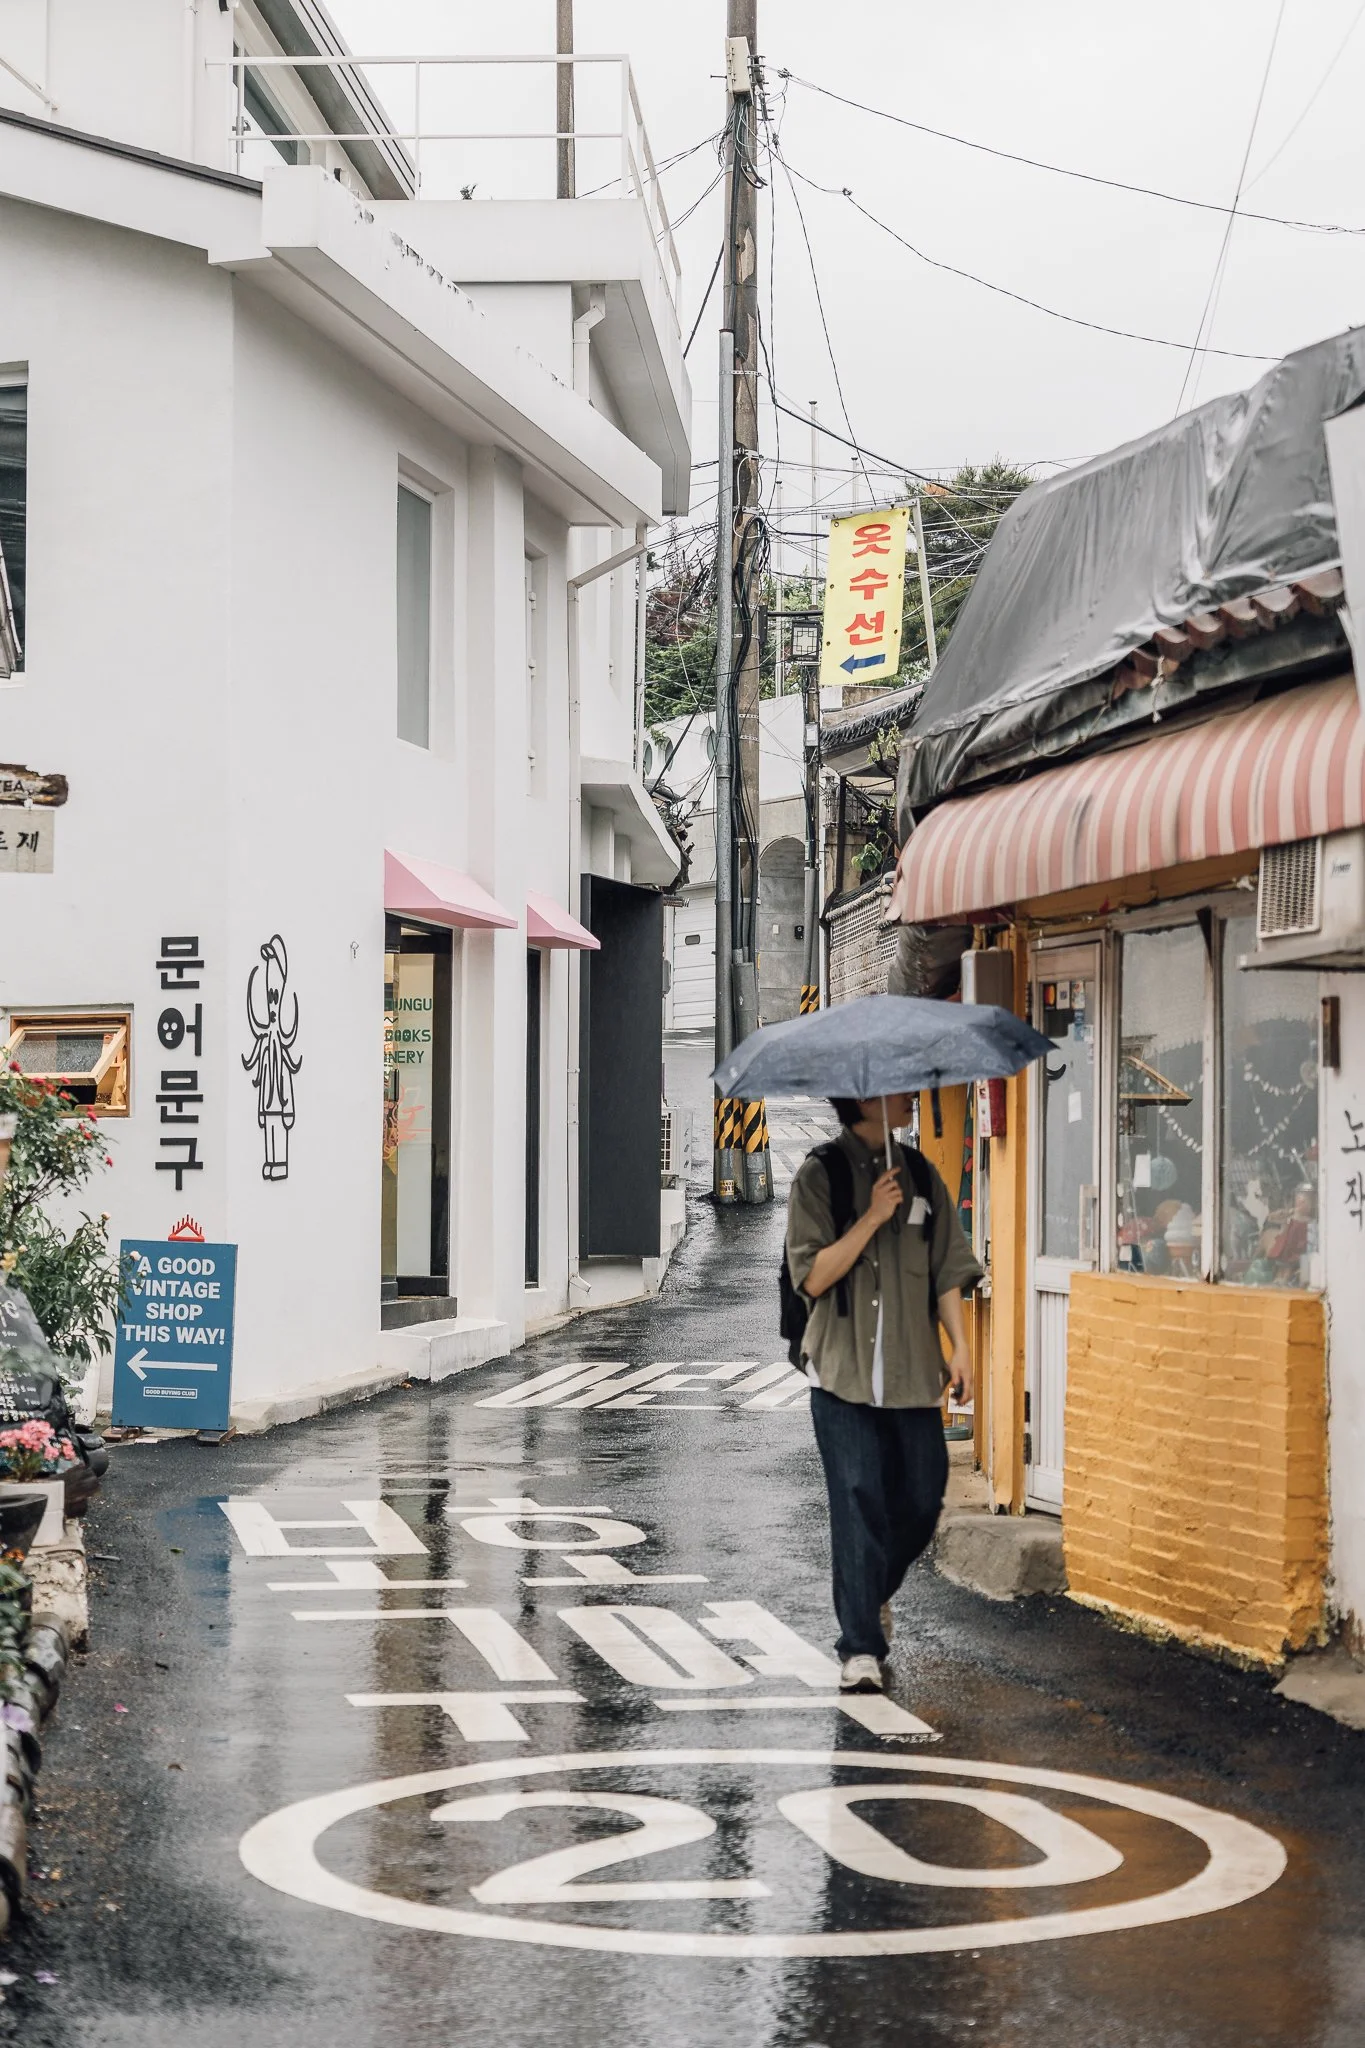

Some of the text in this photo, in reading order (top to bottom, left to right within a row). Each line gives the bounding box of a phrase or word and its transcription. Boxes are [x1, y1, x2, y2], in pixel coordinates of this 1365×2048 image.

[845, 523, 891, 646] 옷수선
[155, 936, 204, 1191] 문어문구
[137, 1256, 215, 1276] A GOOD
[131, 1279, 221, 1299] VINTAGE
[145, 1302, 203, 1321] SHOP
[122, 1324, 226, 1345] THIS WAY!
[430, 1785, 1124, 1905] 20
